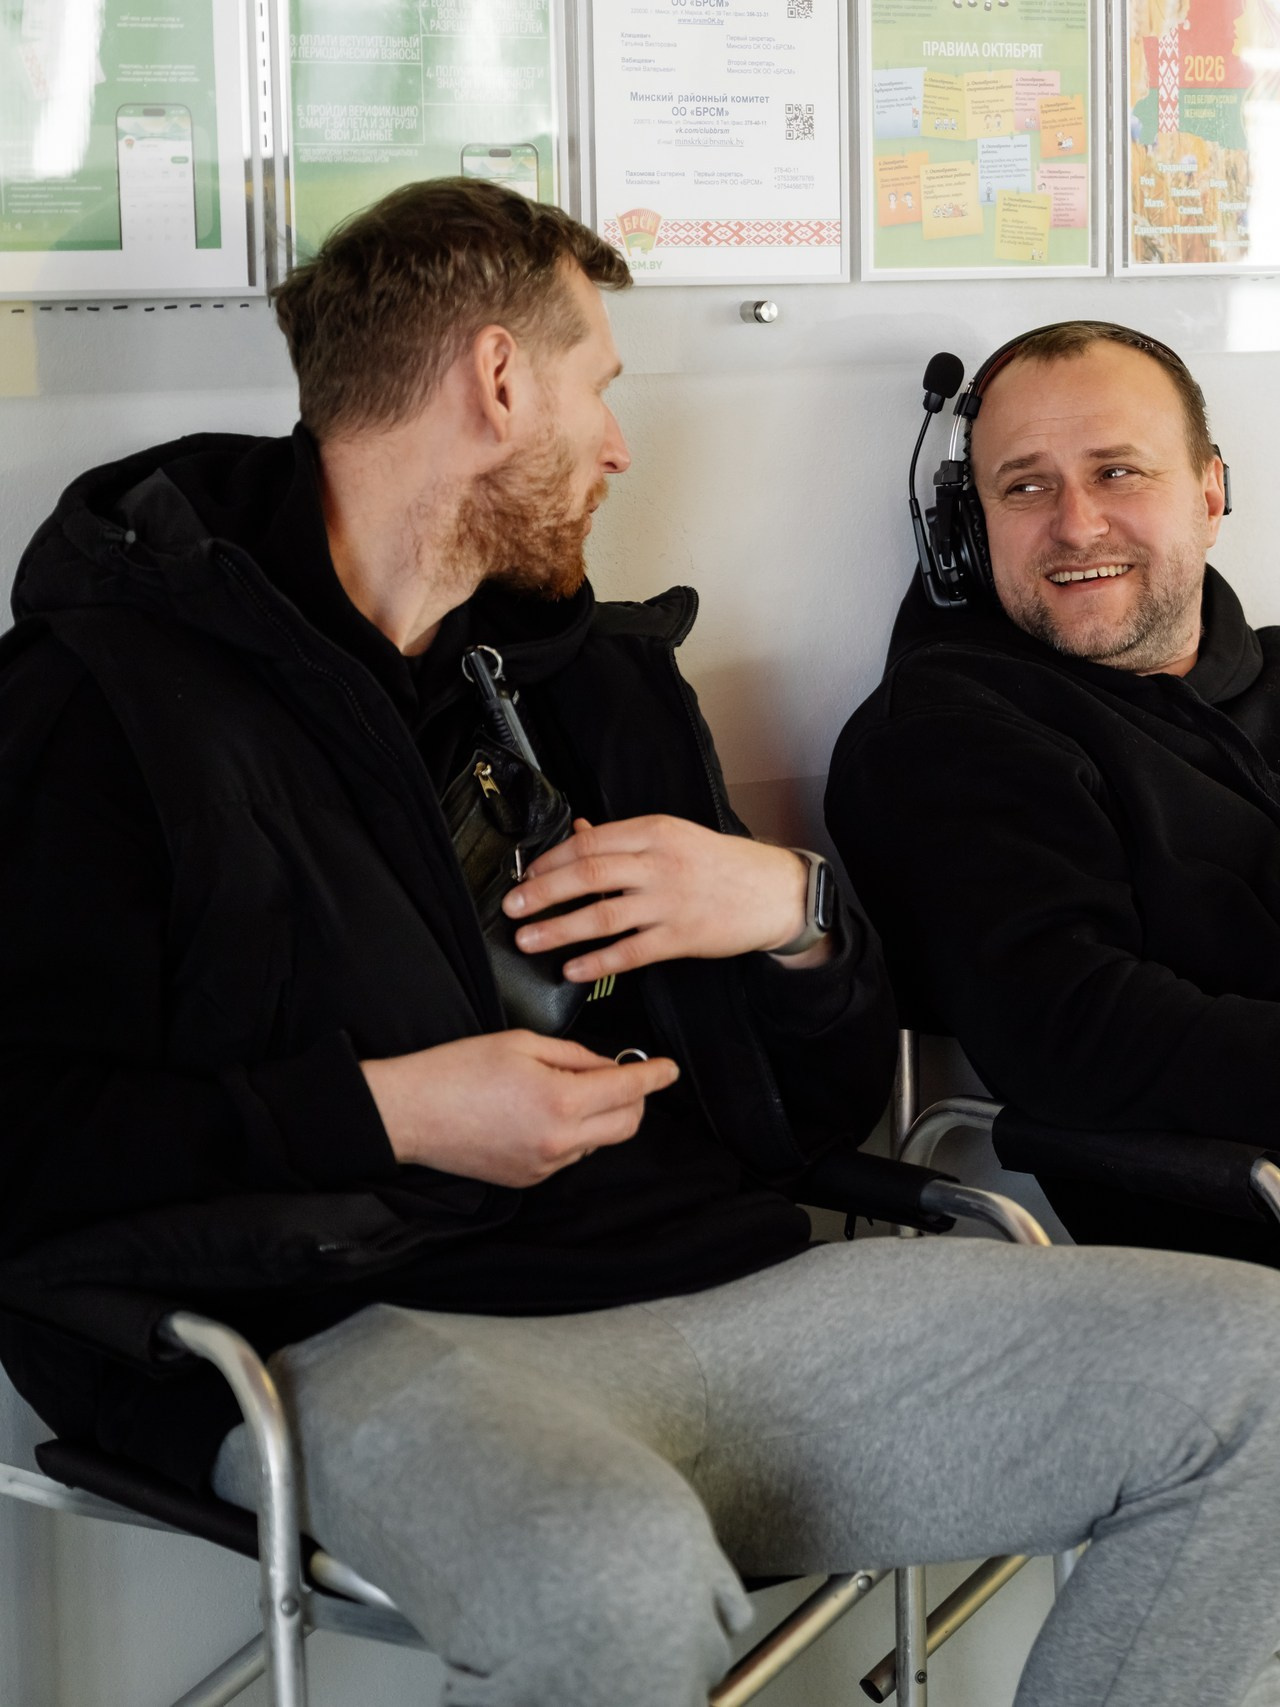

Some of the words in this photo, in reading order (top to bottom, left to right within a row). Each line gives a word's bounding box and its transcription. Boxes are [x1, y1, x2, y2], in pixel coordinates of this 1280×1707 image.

[381, 48, 421, 61] ВЗНОСЫ
[922, 40, 980, 57] ПРАВИЛА
[982, 42, 1044, 59] ОКТЯБРЯТ
[1184, 54, 1226, 82] 2026
[629, 91, 674, 103] Минский
[677, 93, 728, 104] районный
[730, 95, 770, 104] комитет
[671, 106, 687, 117] ОО
[690, 106, 730, 117] «БРСМ»
[352, 129, 394, 142] ДАННЫЕ
[623, 215, 657, 232] БРСМ
